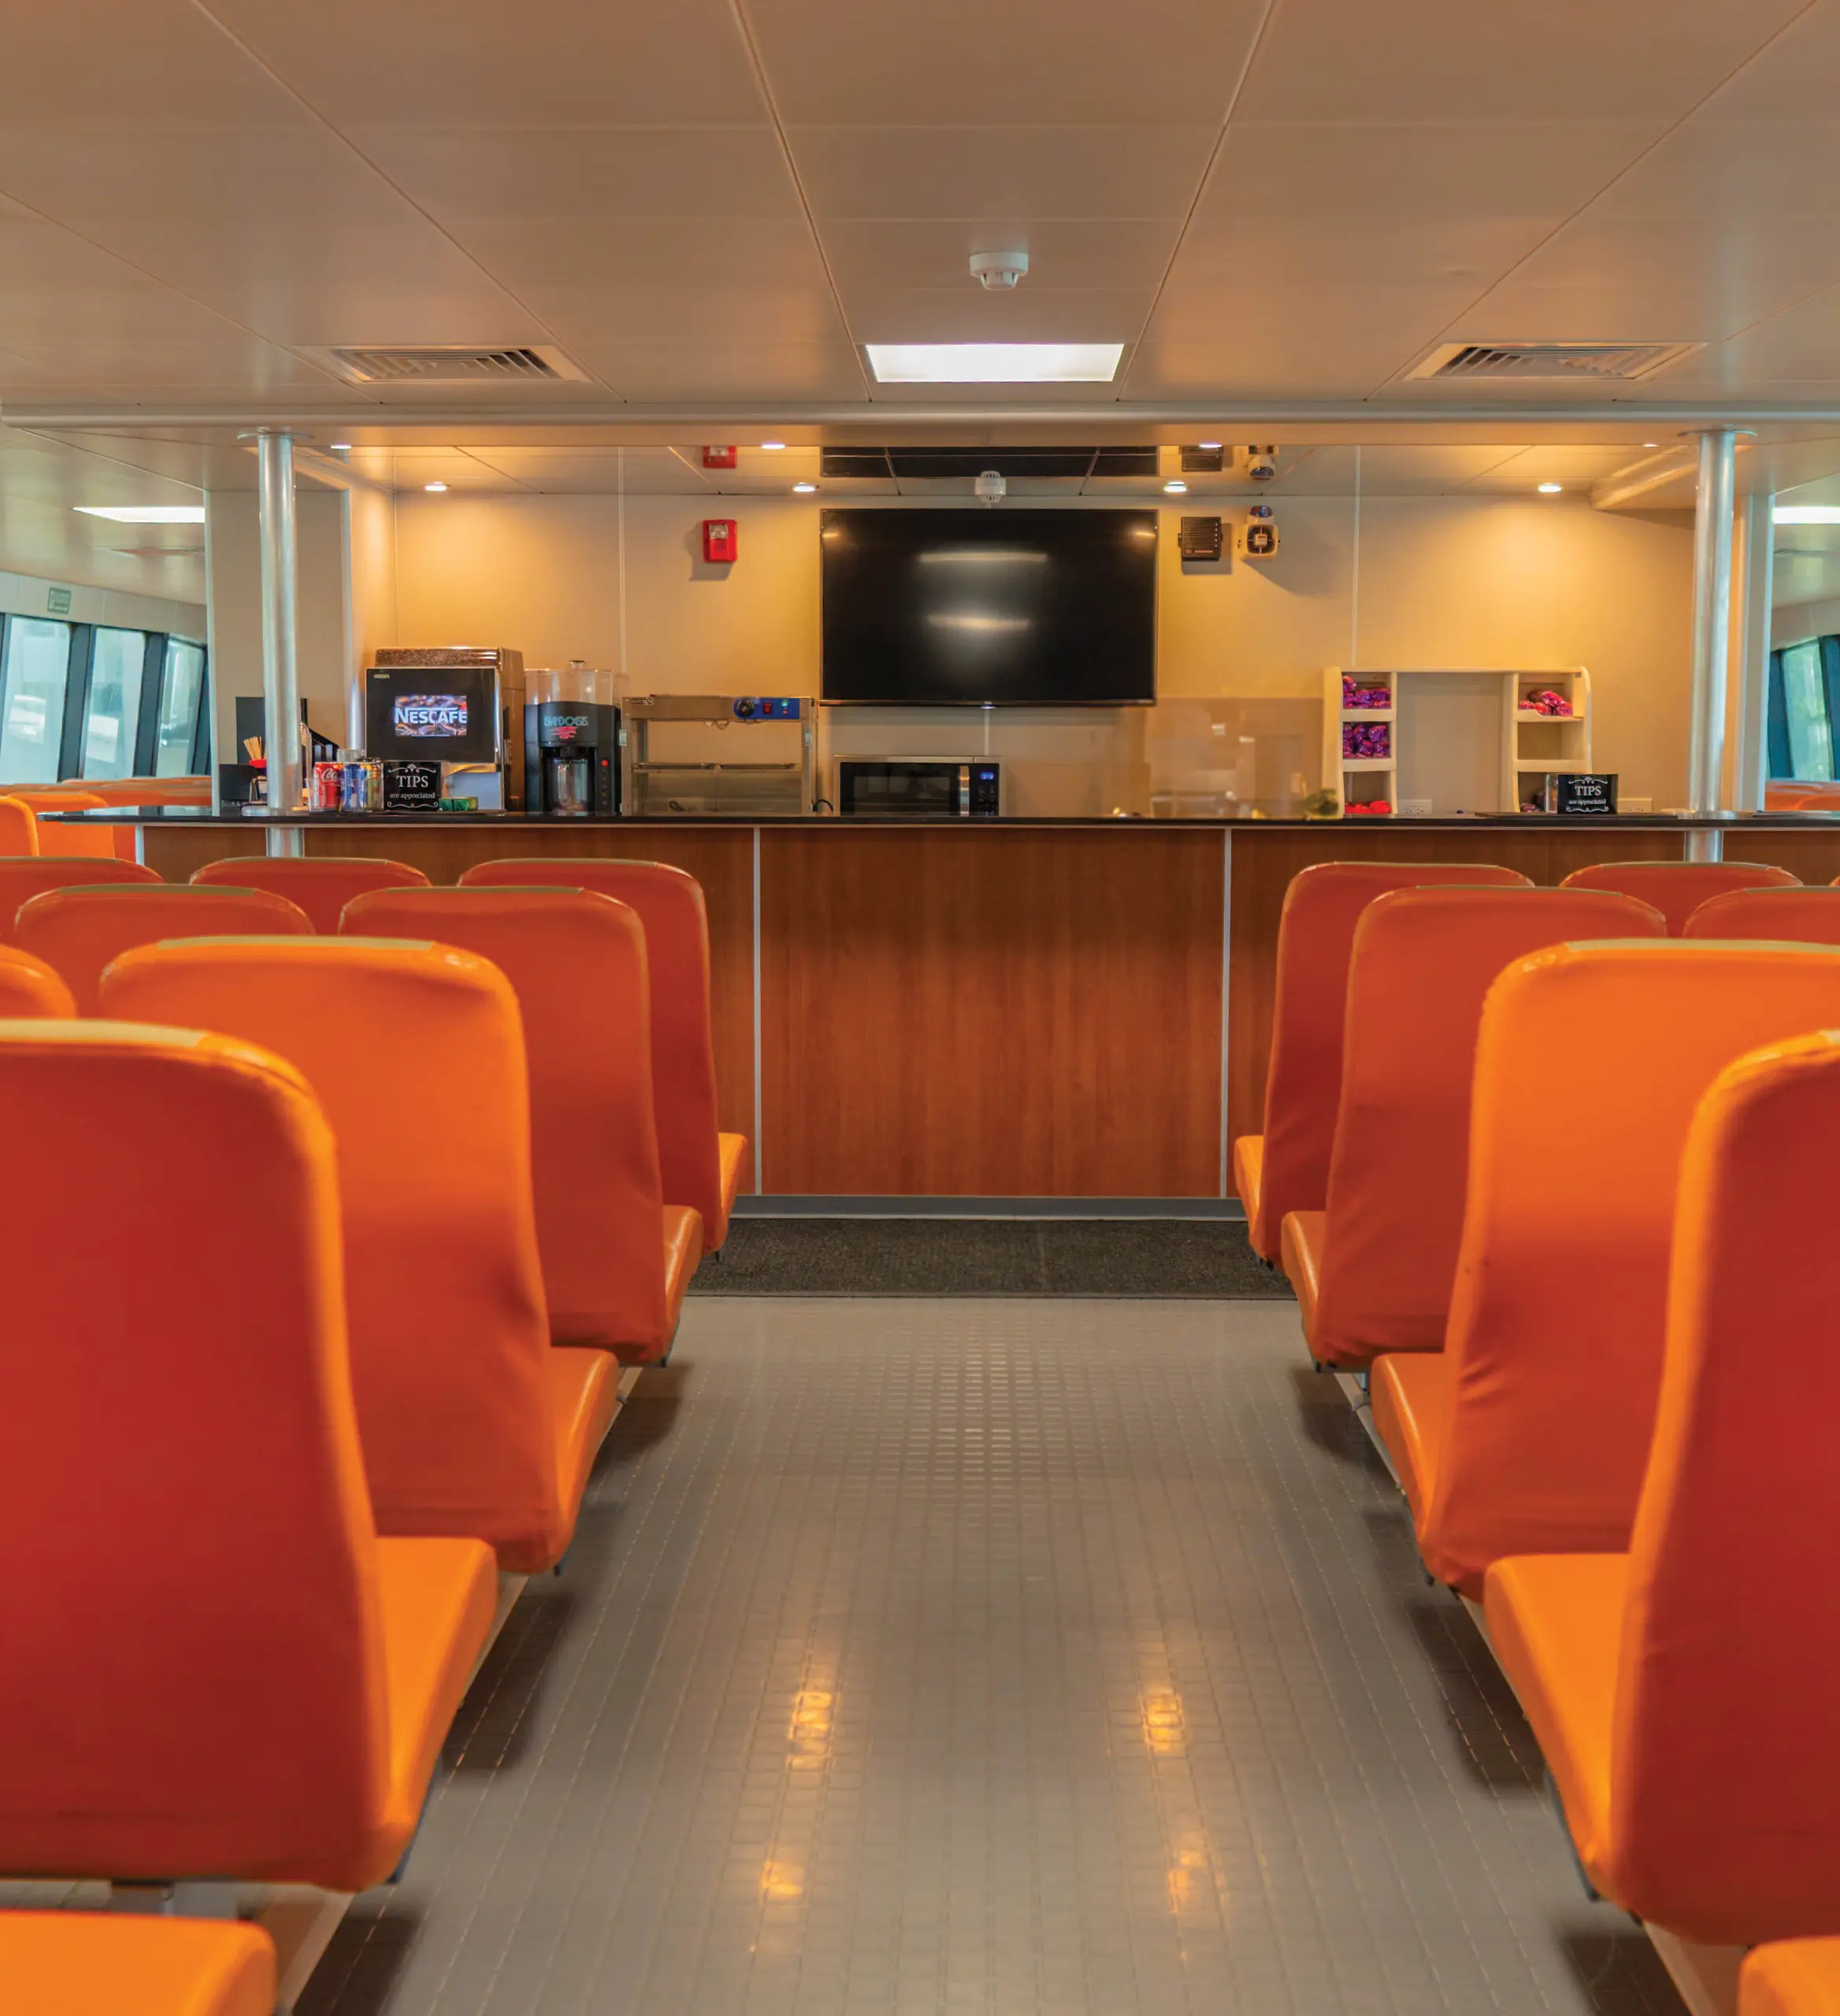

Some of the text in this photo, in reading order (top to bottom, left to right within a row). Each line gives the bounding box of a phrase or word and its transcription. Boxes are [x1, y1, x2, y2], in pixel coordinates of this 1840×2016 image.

[396, 775, 428, 788] TIPS
[400, 791, 436, 800] appreciated
[1575, 785, 1601, 796] TIPS
